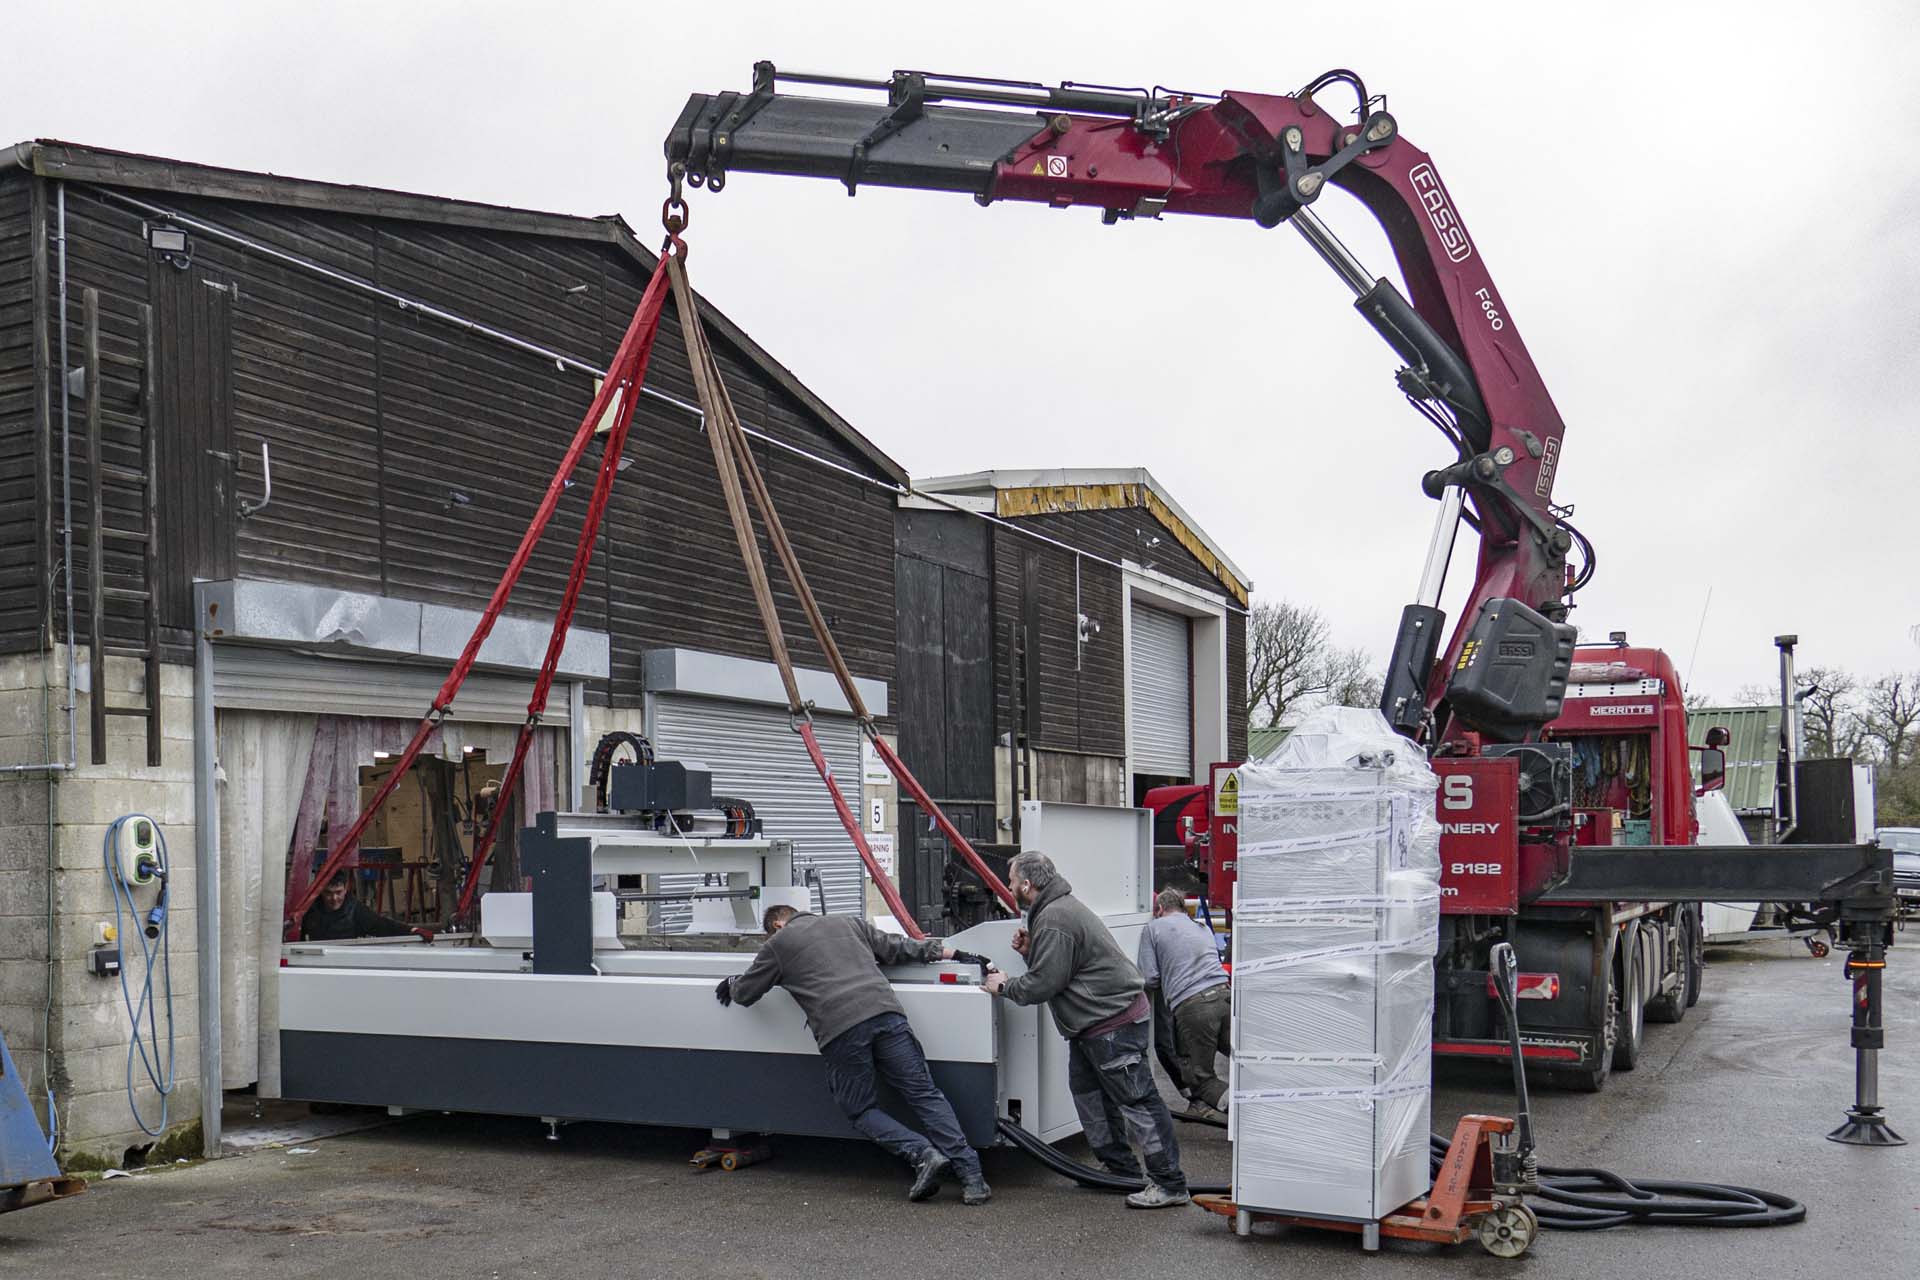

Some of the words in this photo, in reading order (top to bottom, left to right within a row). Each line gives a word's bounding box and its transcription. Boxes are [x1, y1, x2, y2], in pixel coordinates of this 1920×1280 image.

[1414, 170, 1467, 256] FASSI
[1475, 288, 1503, 330] F660
[1537, 440, 1558, 496] FASSI
[1590, 705, 1654, 716] MERRITTS
[1440, 775, 1473, 810] S
[873, 805, 881, 824] 5
[1440, 823, 1500, 834] INERY
[1451, 863, 1502, 875] 8182
